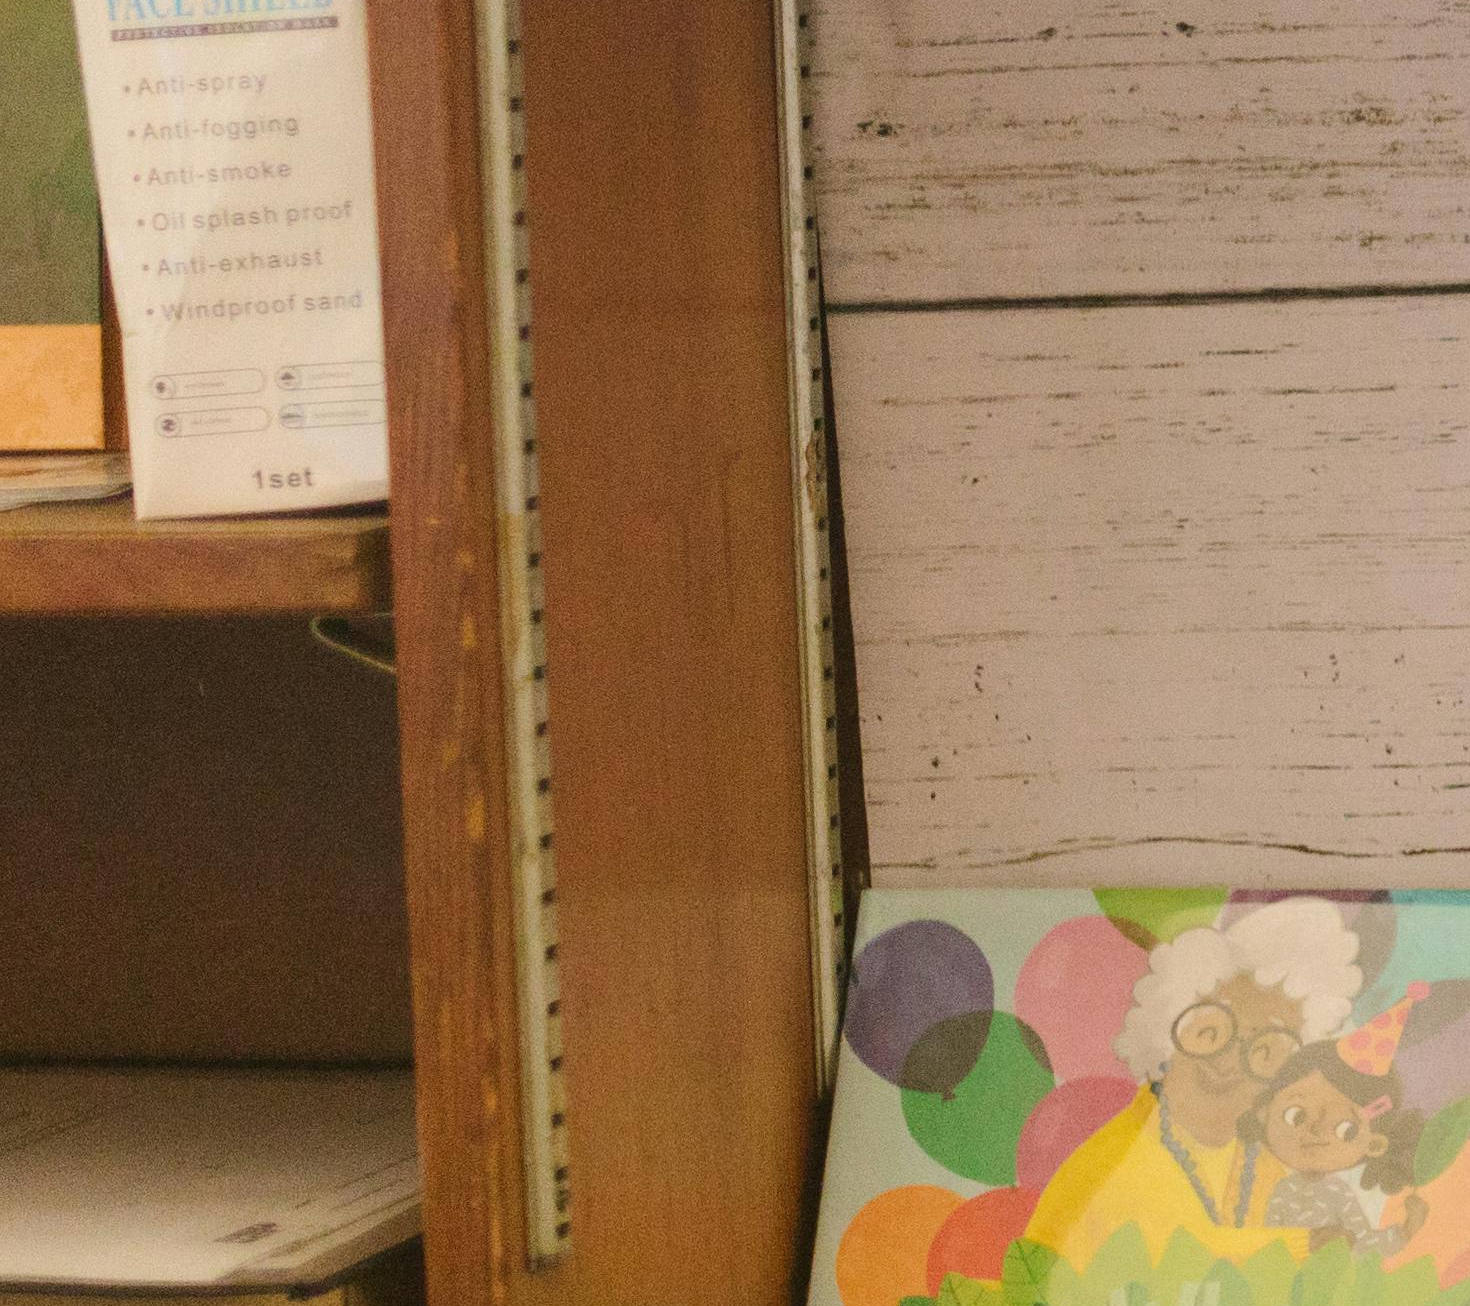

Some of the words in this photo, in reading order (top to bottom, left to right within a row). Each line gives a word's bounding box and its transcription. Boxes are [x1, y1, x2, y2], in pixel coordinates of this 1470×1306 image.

[142, 116, 300, 141] Anti-fogging
[147, 162, 292, 186] Anti-smoke
[151, 211, 186, 232] Oil
[193, 207, 279, 233] splash
[286, 200, 353, 227] proof
[157, 249, 323, 277] Anti-exhaust
[161, 293, 296, 322] Windproof
[303, 290, 364, 312] sand
